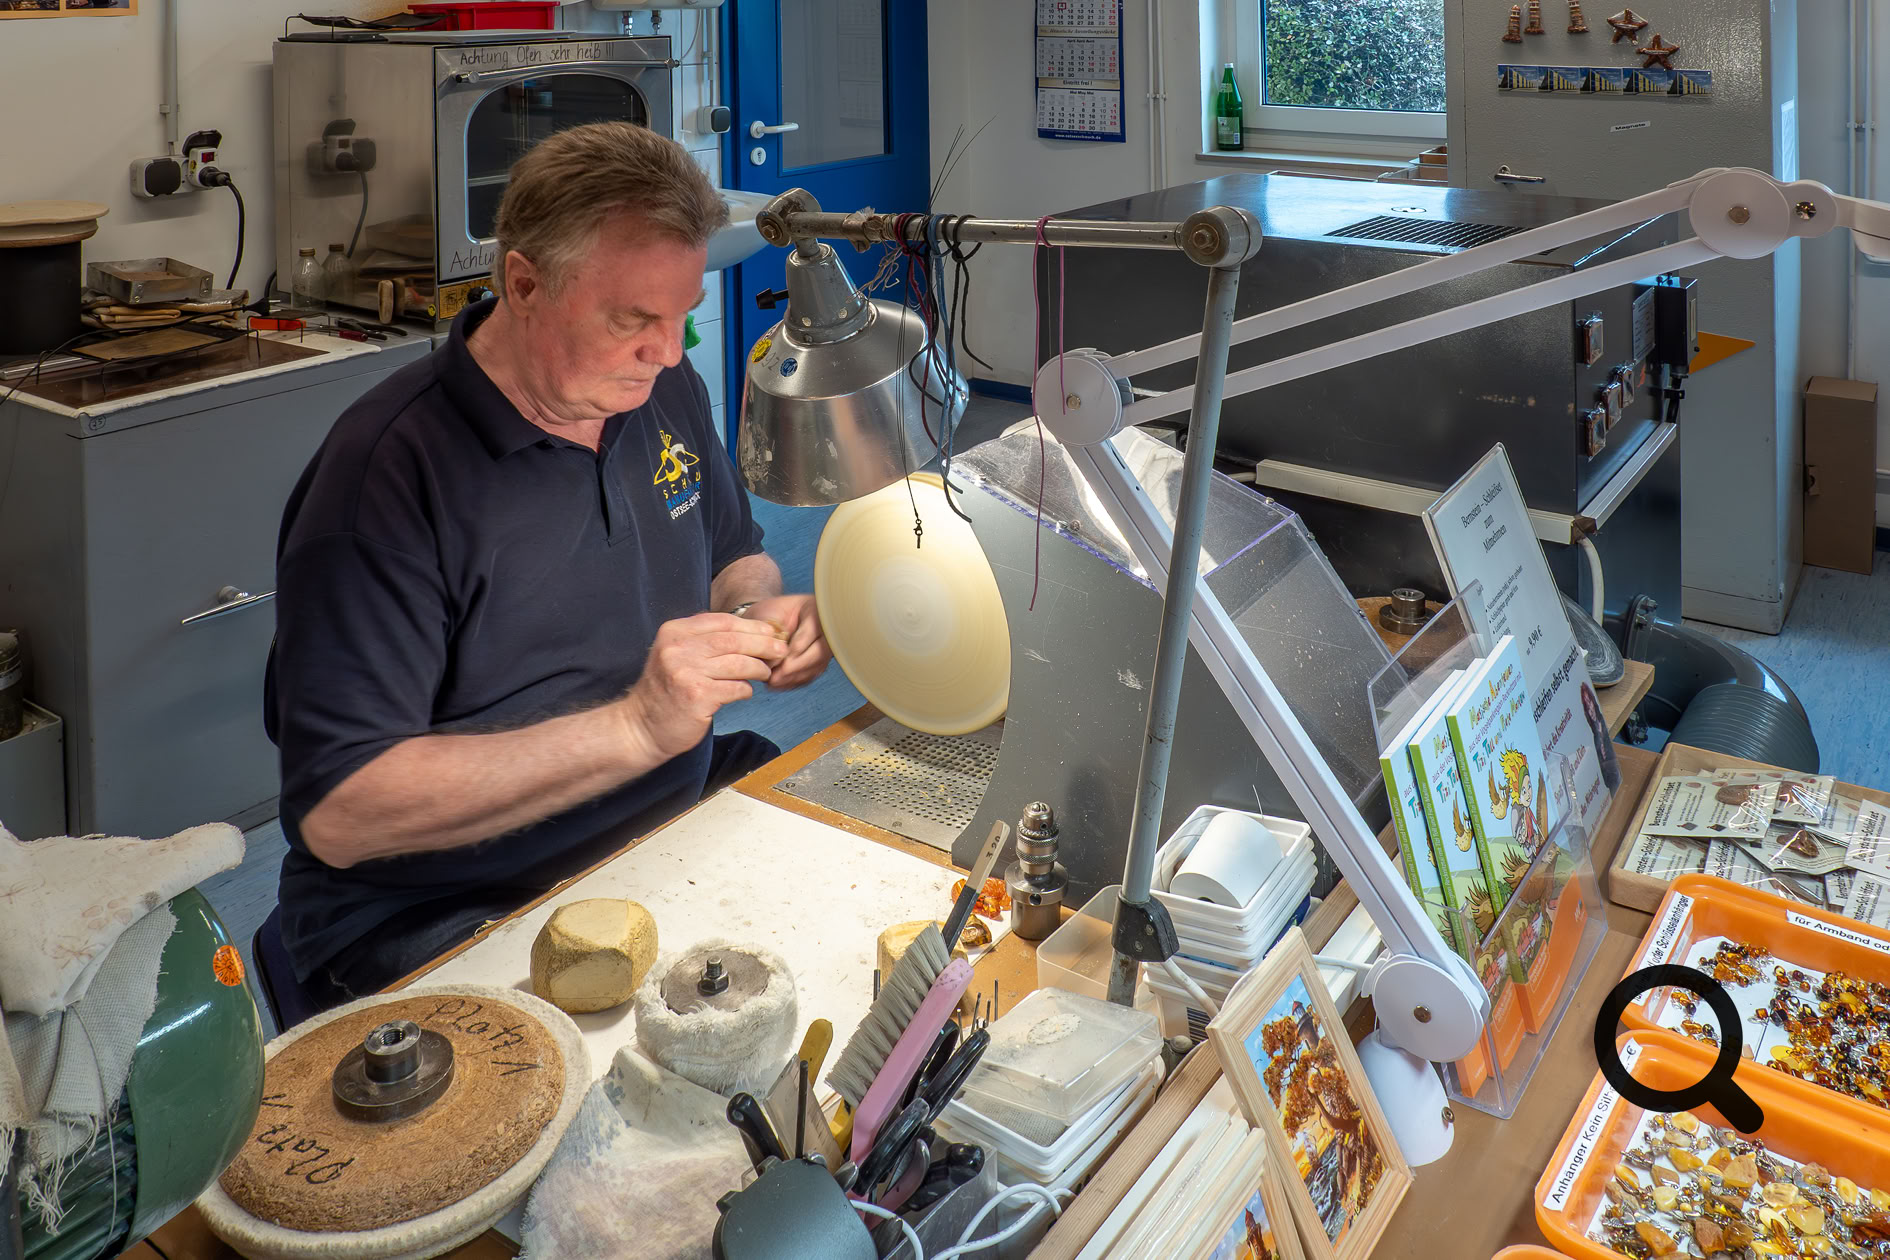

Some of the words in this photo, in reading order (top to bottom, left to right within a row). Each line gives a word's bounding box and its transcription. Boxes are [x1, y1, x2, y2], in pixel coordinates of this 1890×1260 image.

[460, 49, 509, 70] Achtung
[516, 45, 542, 66] Ofen
[549, 43, 570, 60] sehr
[576, 41, 601, 60] heiß
[1461, 503, 1482, 528] Bernstein
[1482, 482, 1503, 507] Schleifset
[1483, 514, 1494, 529] zum
[1483, 525, 1507, 553] Mitnehmen
[1528, 629, 1540, 652] 9,90
[1537, 624, 1544, 638] €
[1551, 667, 1564, 695] selbst
[1562, 646, 1580, 682] gemacht
[1656, 894, 1687, 950] Schlüsselanhänger
[1794, 915, 1812, 926] für
[1814, 923, 1871, 945] Armband
[1651, 944, 1664, 964] oder
[1552, 1142, 1588, 1204] Anhänger
[1582, 1114, 1603, 1142] Kein
